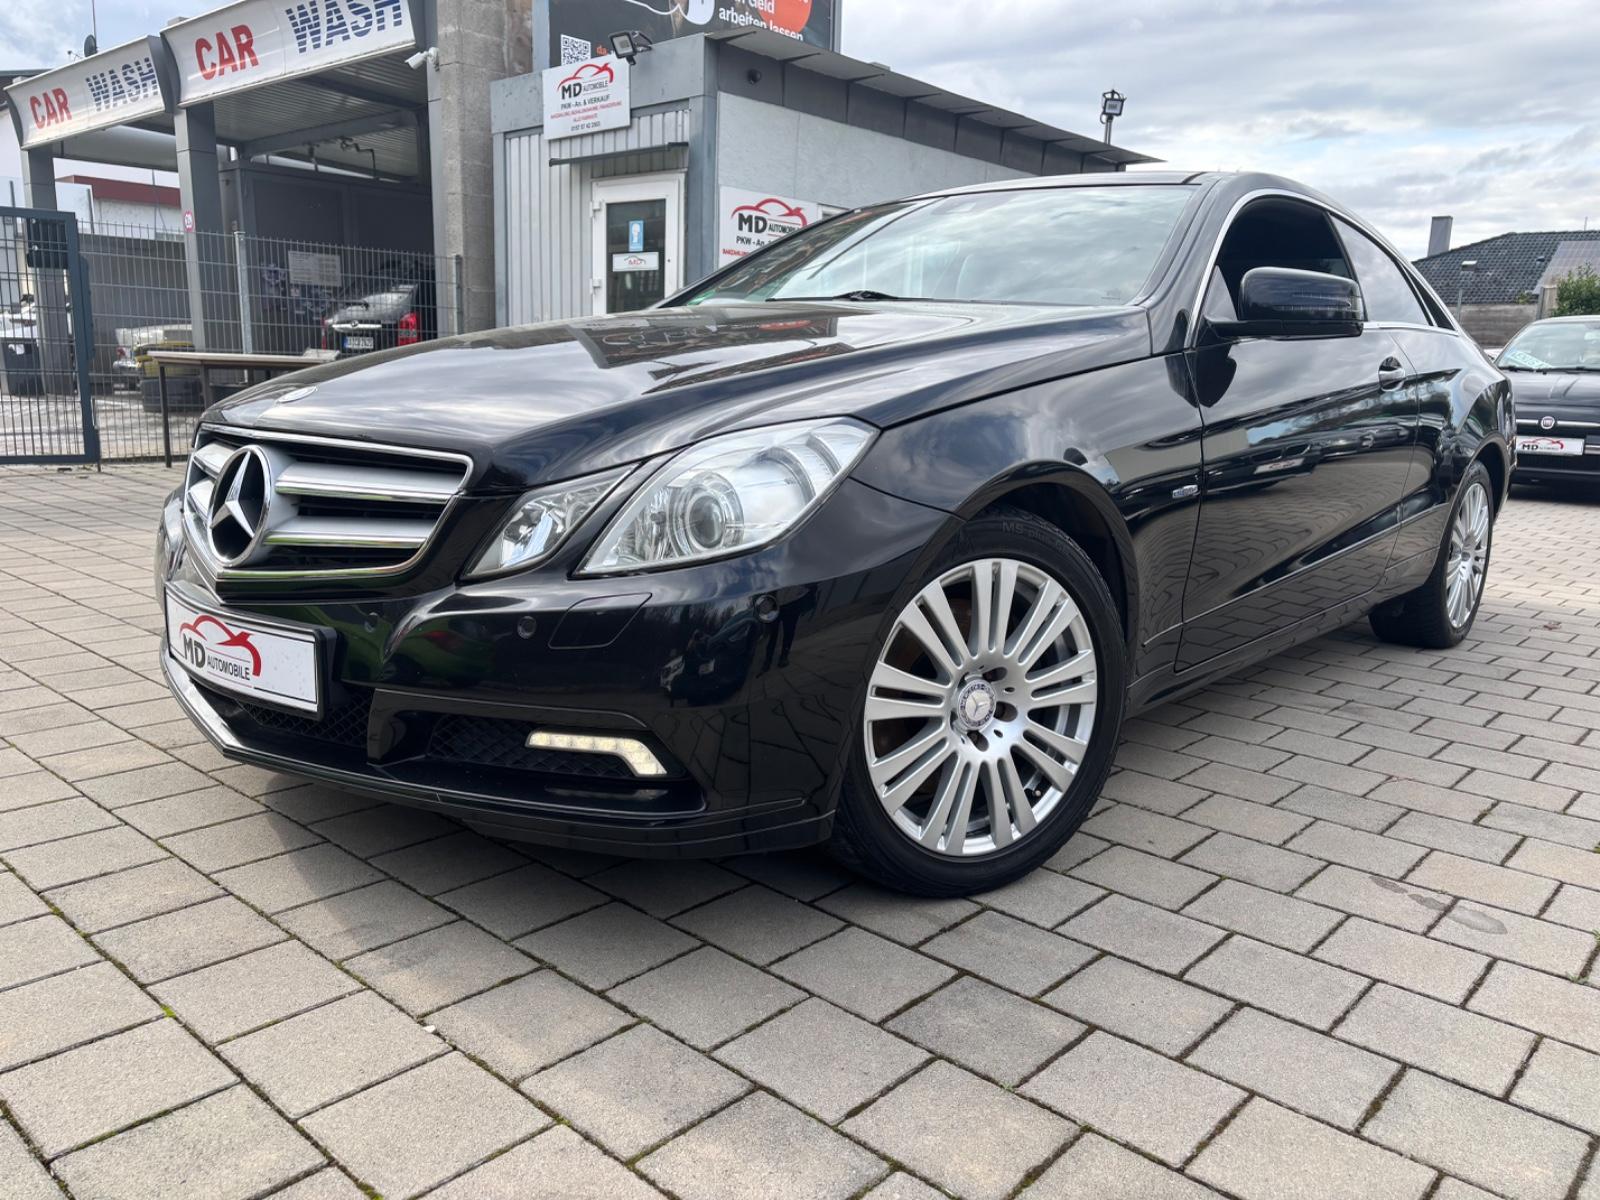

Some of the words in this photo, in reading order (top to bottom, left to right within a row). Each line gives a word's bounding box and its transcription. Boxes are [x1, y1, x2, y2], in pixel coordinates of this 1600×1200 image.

[718, 6, 767, 29] arbeiten
[195, 24, 259, 81] CAR
[285, 0, 403, 54] WASH
[29, 87, 73, 130] CAR
[86, 57, 159, 112] WASH
[561, 82, 582, 100] MD
[583, 80, 609, 92] AUTOMOBILE
[738, 213, 767, 234] MD
[736, 235, 752, 245] PKW
[1522, 443, 1539, 451] MD
[182, 633, 206, 669] MD
[207, 655, 250, 680] AUTOMOBILE
